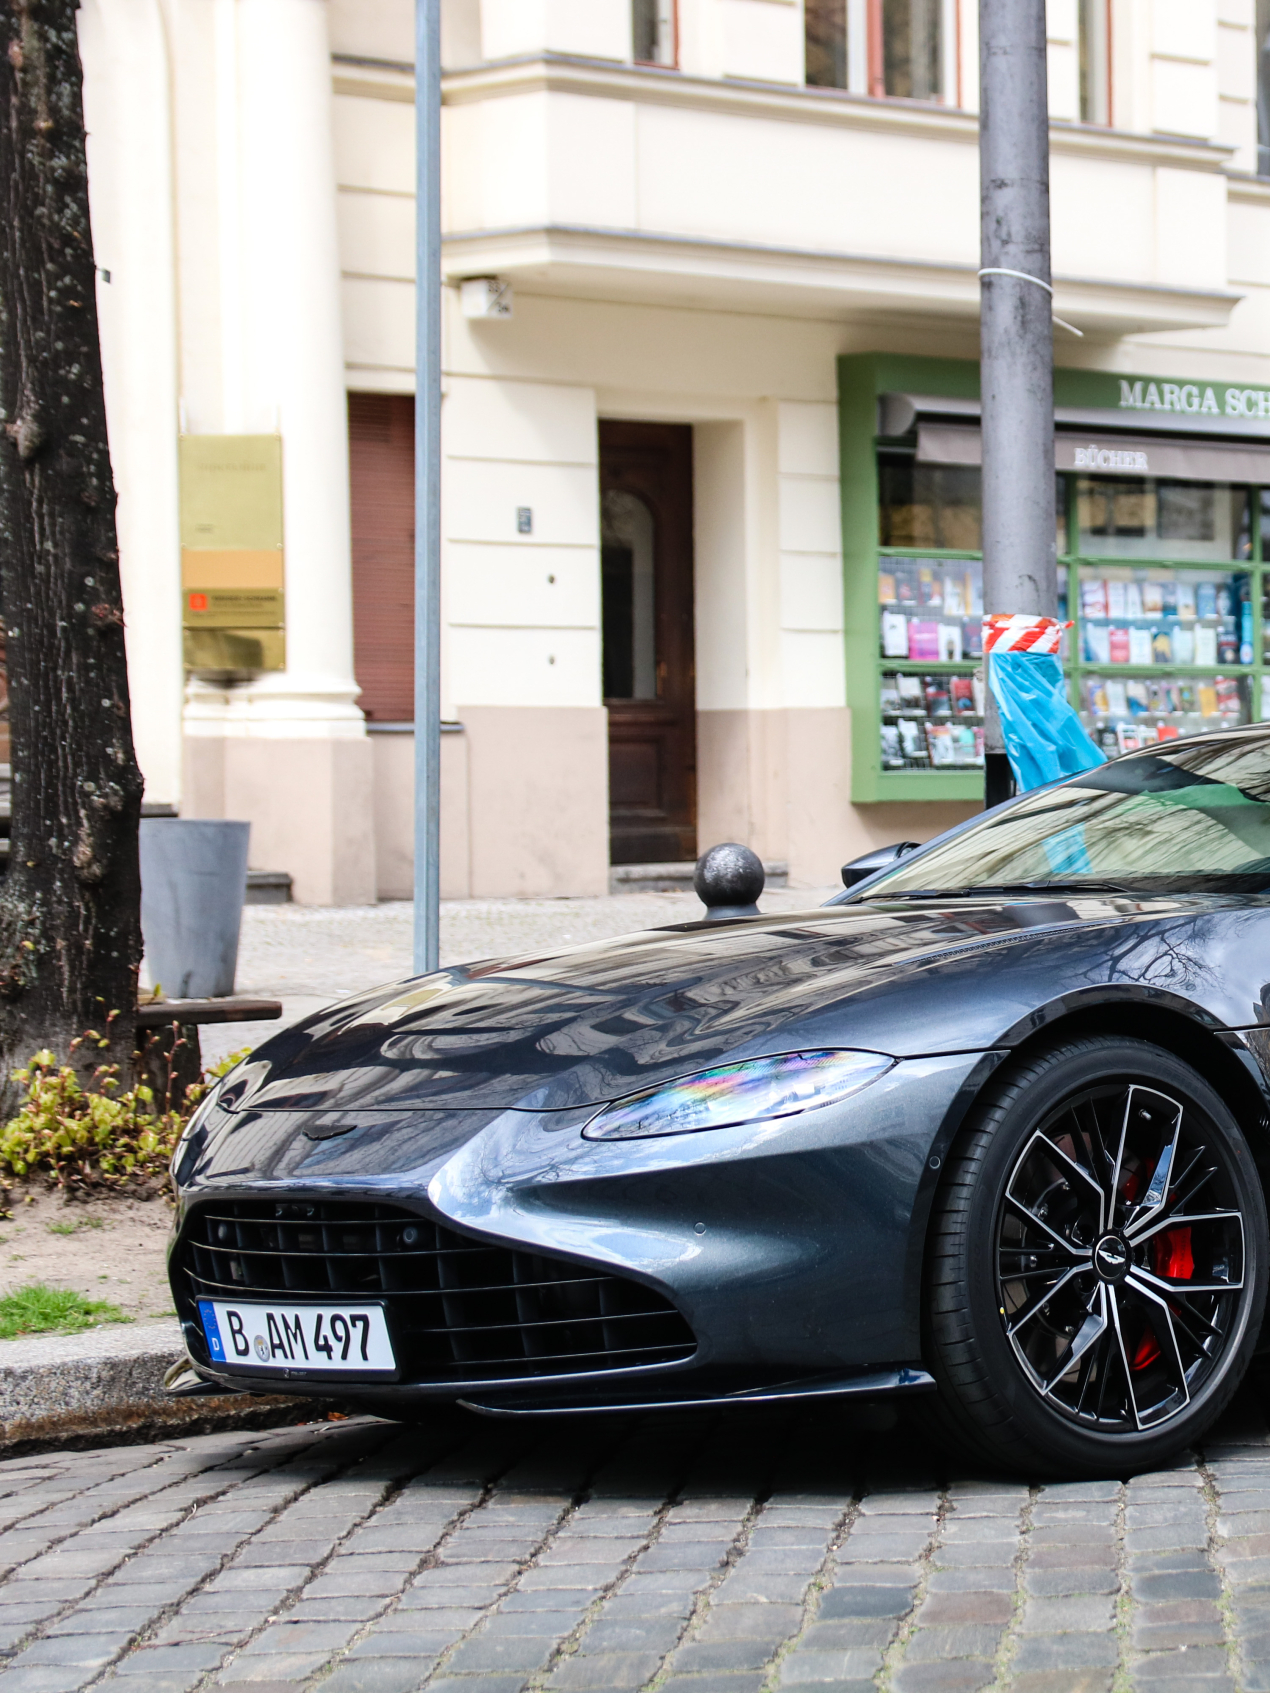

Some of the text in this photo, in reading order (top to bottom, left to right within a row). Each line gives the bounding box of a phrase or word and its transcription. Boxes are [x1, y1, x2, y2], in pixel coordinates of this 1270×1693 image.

[1118, 380, 1220, 414] MARGA
[1074, 444, 1149, 471] BÜCHER
[211, 1337, 221, 1351] D
[226, 1310, 370, 1361] B AM 497
